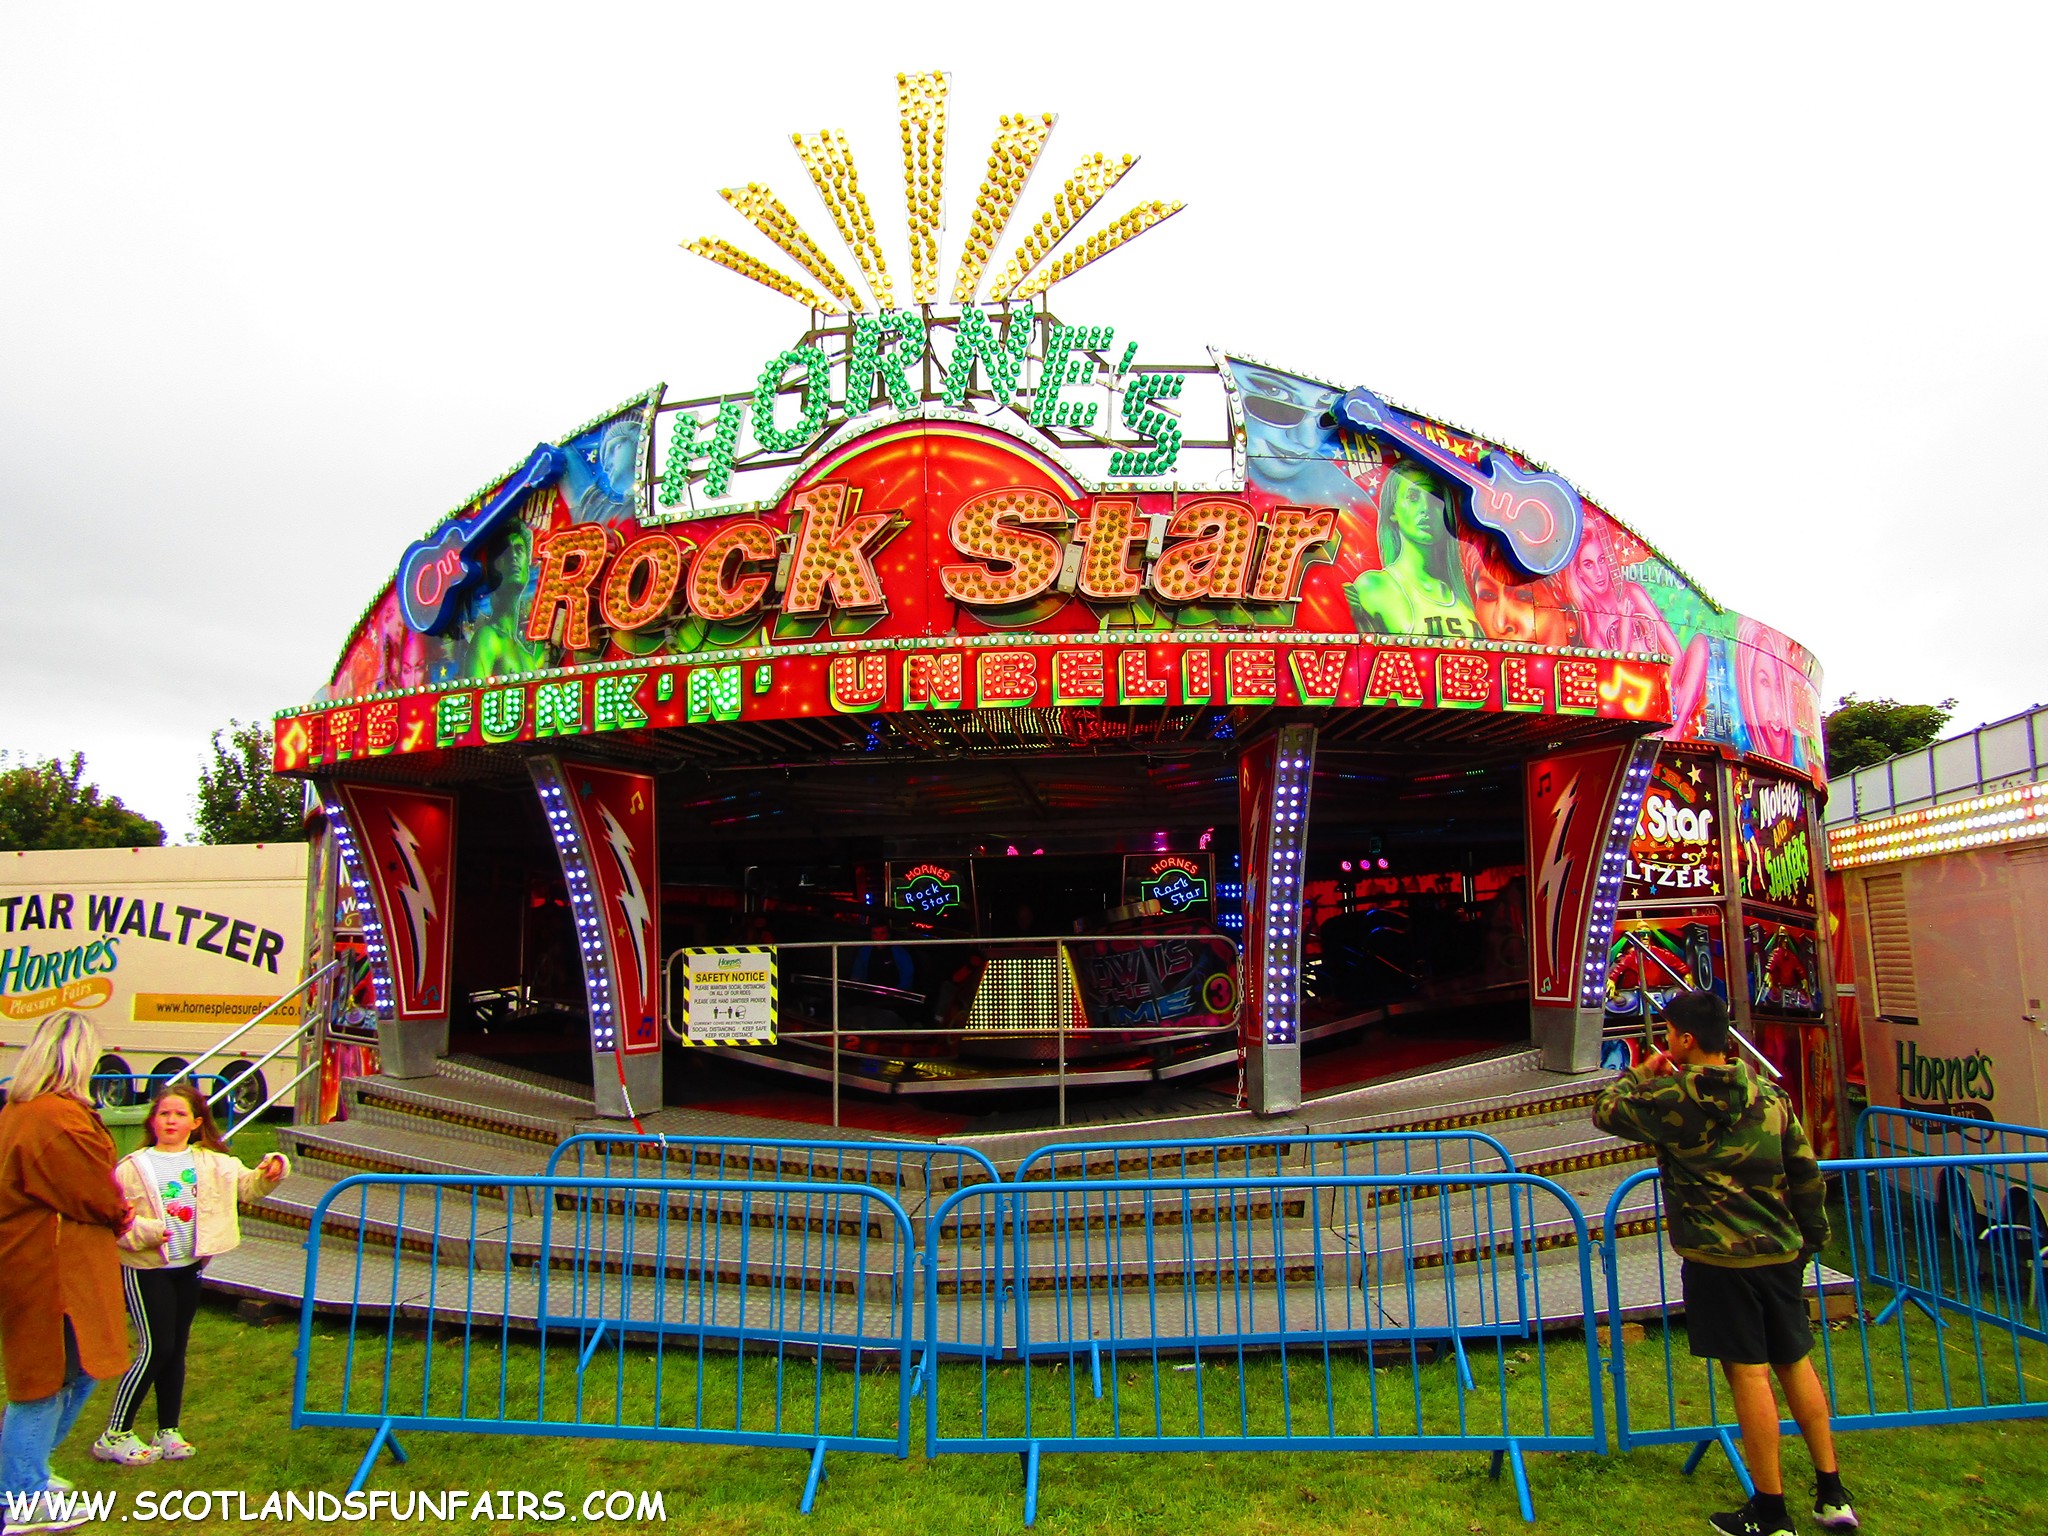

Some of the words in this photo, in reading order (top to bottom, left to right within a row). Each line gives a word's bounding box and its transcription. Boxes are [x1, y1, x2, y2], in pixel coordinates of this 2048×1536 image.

[657, 303, 1186, 508] HORNE'S
[1338, 428, 1383, 479] LAS
[525, 477, 906, 650] Rock
[938, 485, 1340, 605] Star
[1424, 616, 1486, 641] USA
[306, 702, 400, 764] ITS
[828, 648, 1599, 716] UNBELIEVABLE
[1646, 796, 1714, 844] Star
[1759, 779, 1799, 830] MOVERS
[1772, 819, 1788, 849] AND
[905, 864, 950, 881] HORNES
[1151, 857, 1198, 874] HORNES
[1764, 831, 1810, 901] SHAKERS
[905, 883, 939, 904] Rock
[921, 893, 950, 911] Star
[1153, 877, 1189, 898] Rock
[1170, 887, 1200, 906] Star
[88, 894, 284, 974] WALTZER
[695, 973, 730, 982] SAFETY
[731, 971, 765, 982] NOTICE
[1209, 977, 1230, 1008] 3
[9, 995, 58, 1015] Pleasure
[62, 981, 93, 1003] Fairs
[1896, 1039, 1994, 1104] Horne's
